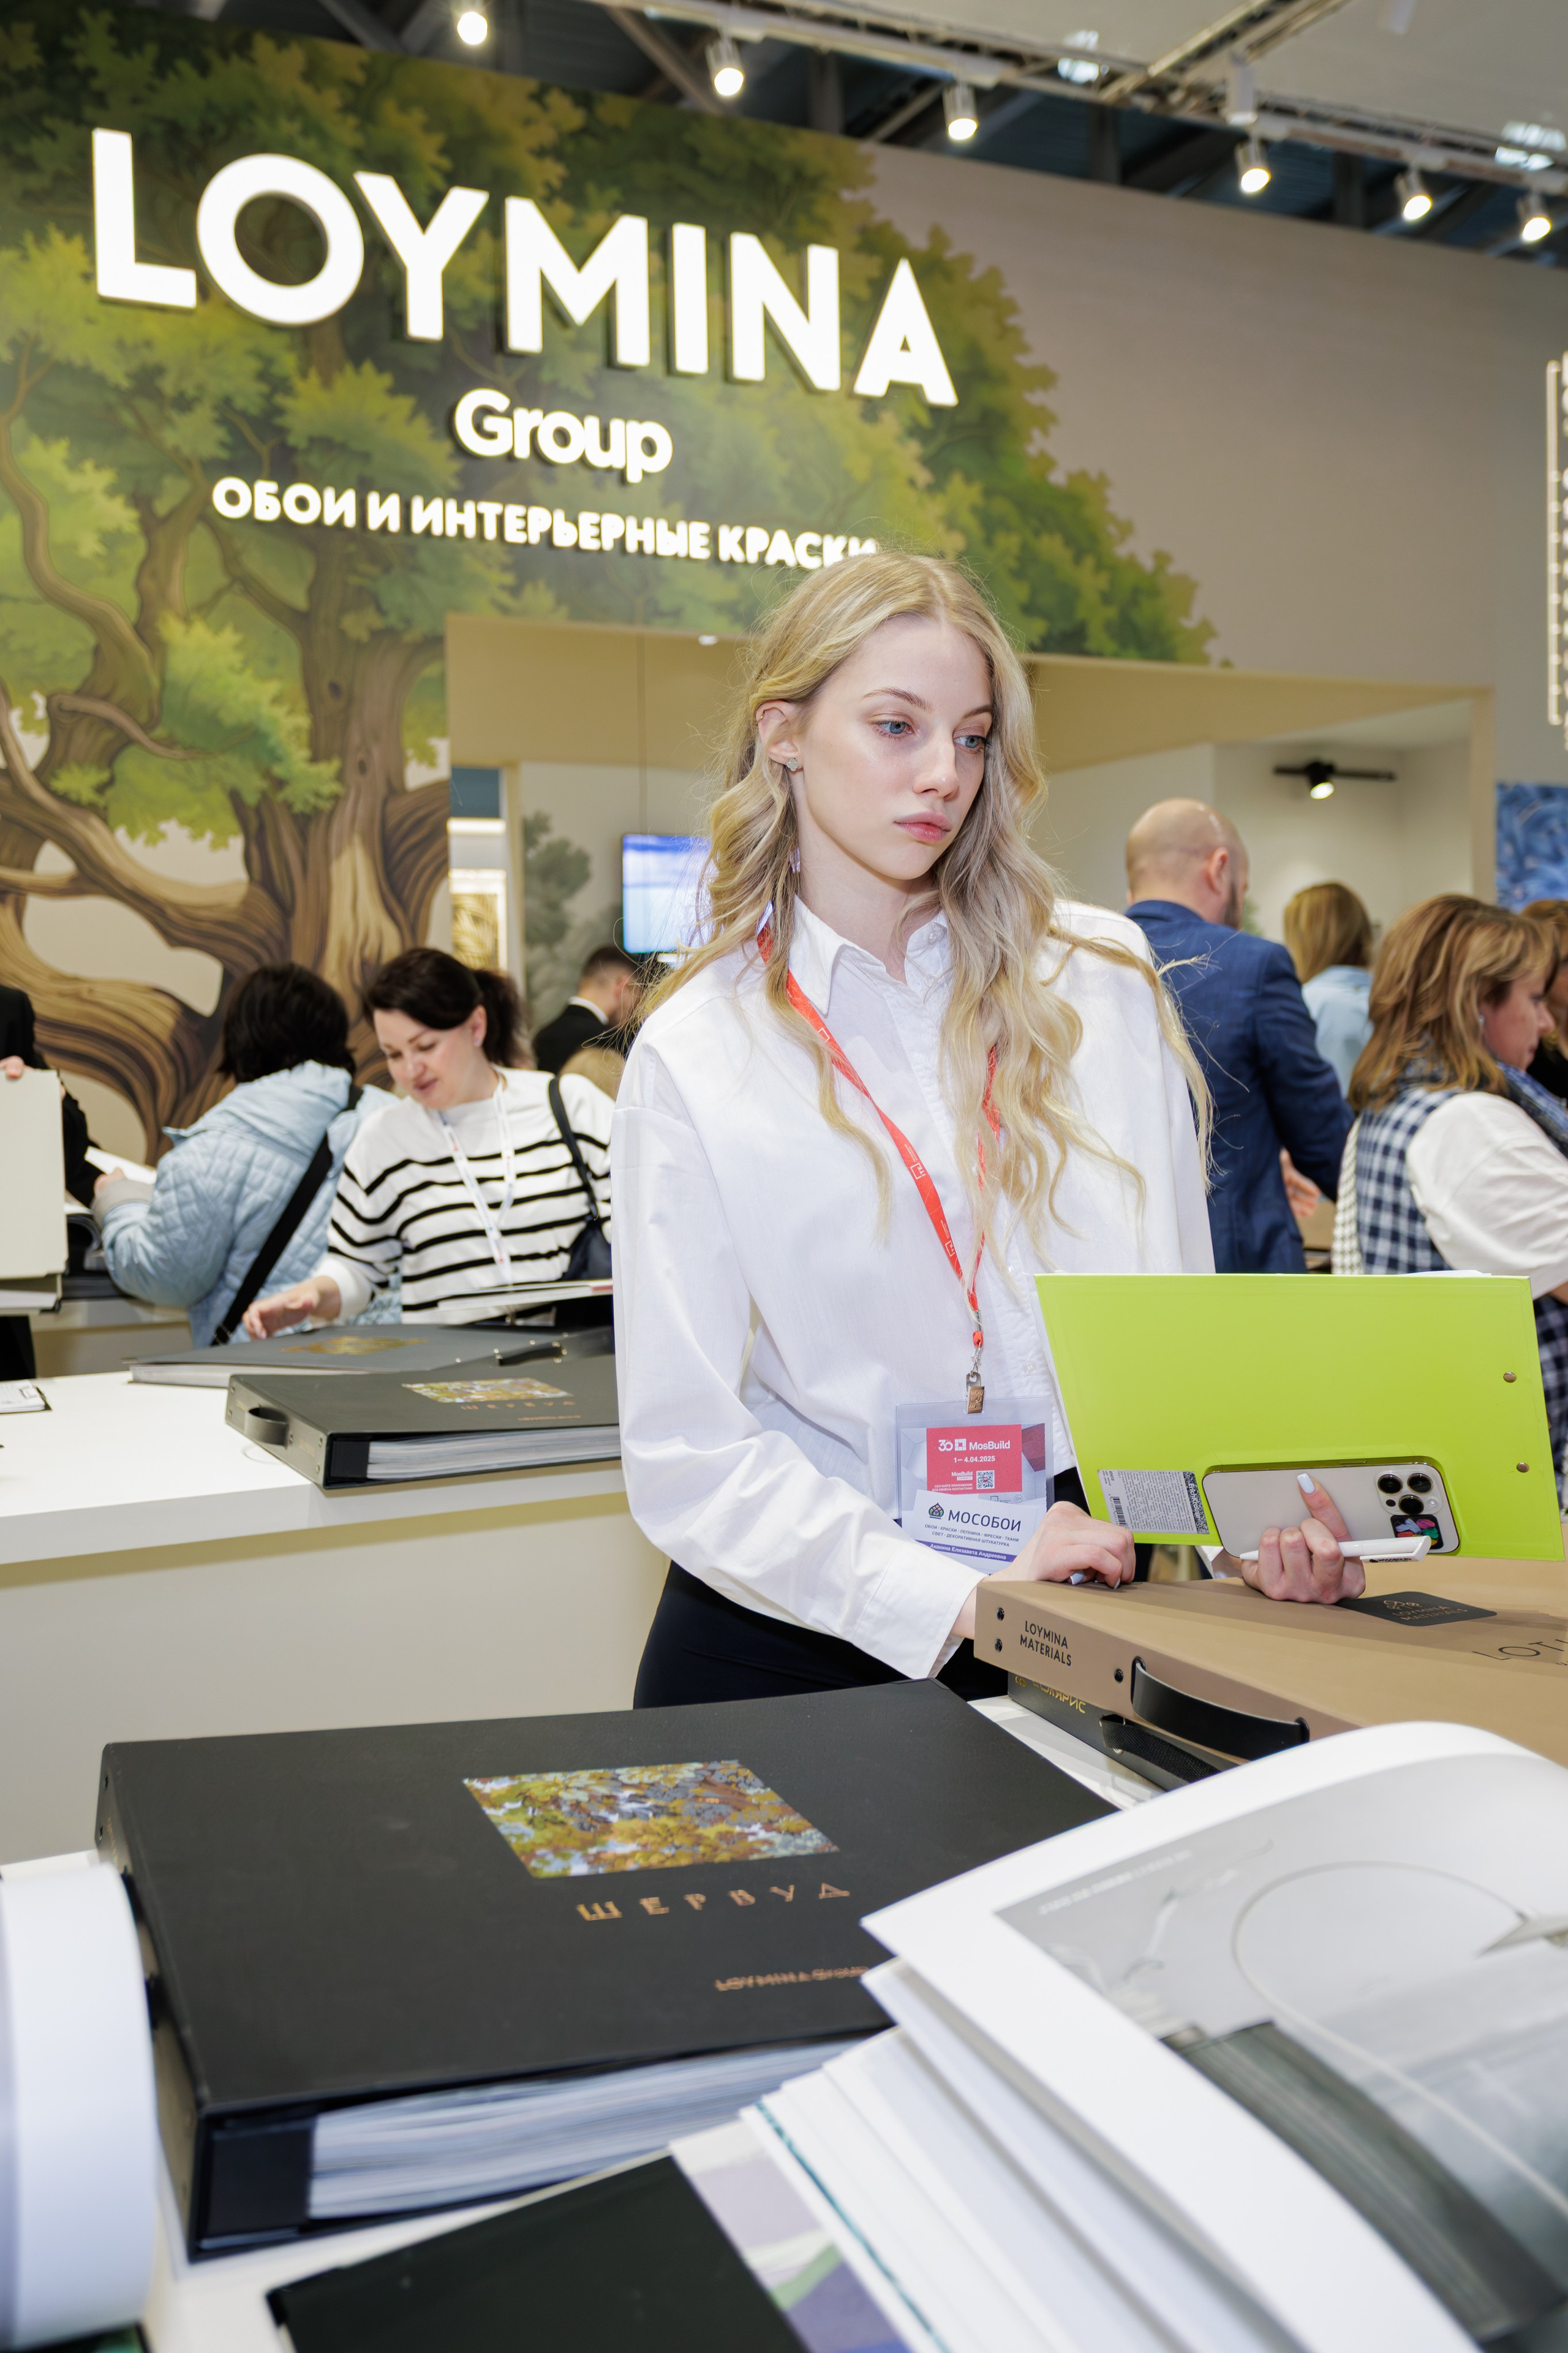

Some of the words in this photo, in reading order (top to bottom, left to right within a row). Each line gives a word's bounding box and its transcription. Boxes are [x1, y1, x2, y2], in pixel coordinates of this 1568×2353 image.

[92, 128, 958, 406] LOYMINA
[454, 388, 673, 483] Group
[213, 477, 356, 527] ОБОИ
[368, 491, 400, 532] И
[412, 495, 710, 560] ИНТЕРЬЕРНЫЕ
[969, 1440, 1010, 1451] MosBuild
[1188, 1482, 1202, 1519] ErichKrause
[948, 1509, 1021, 1532] МОСОБОИ
[946, 1533, 981, 1543] ДЕКОРАТИВНАЯ
[981, 1538, 1010, 1547] ШТУКАТУРКА
[951, 1547, 978, 1555] Елизавета
[978, 1550, 1006, 1560] Андреевна
[1025, 1620, 1068, 1649] LOYMINA
[1020, 1634, 1071, 1666] MATERIALS
[576, 1882, 851, 1921] ШЕРВУД
[715, 1971, 812, 1992] LOYMINA
